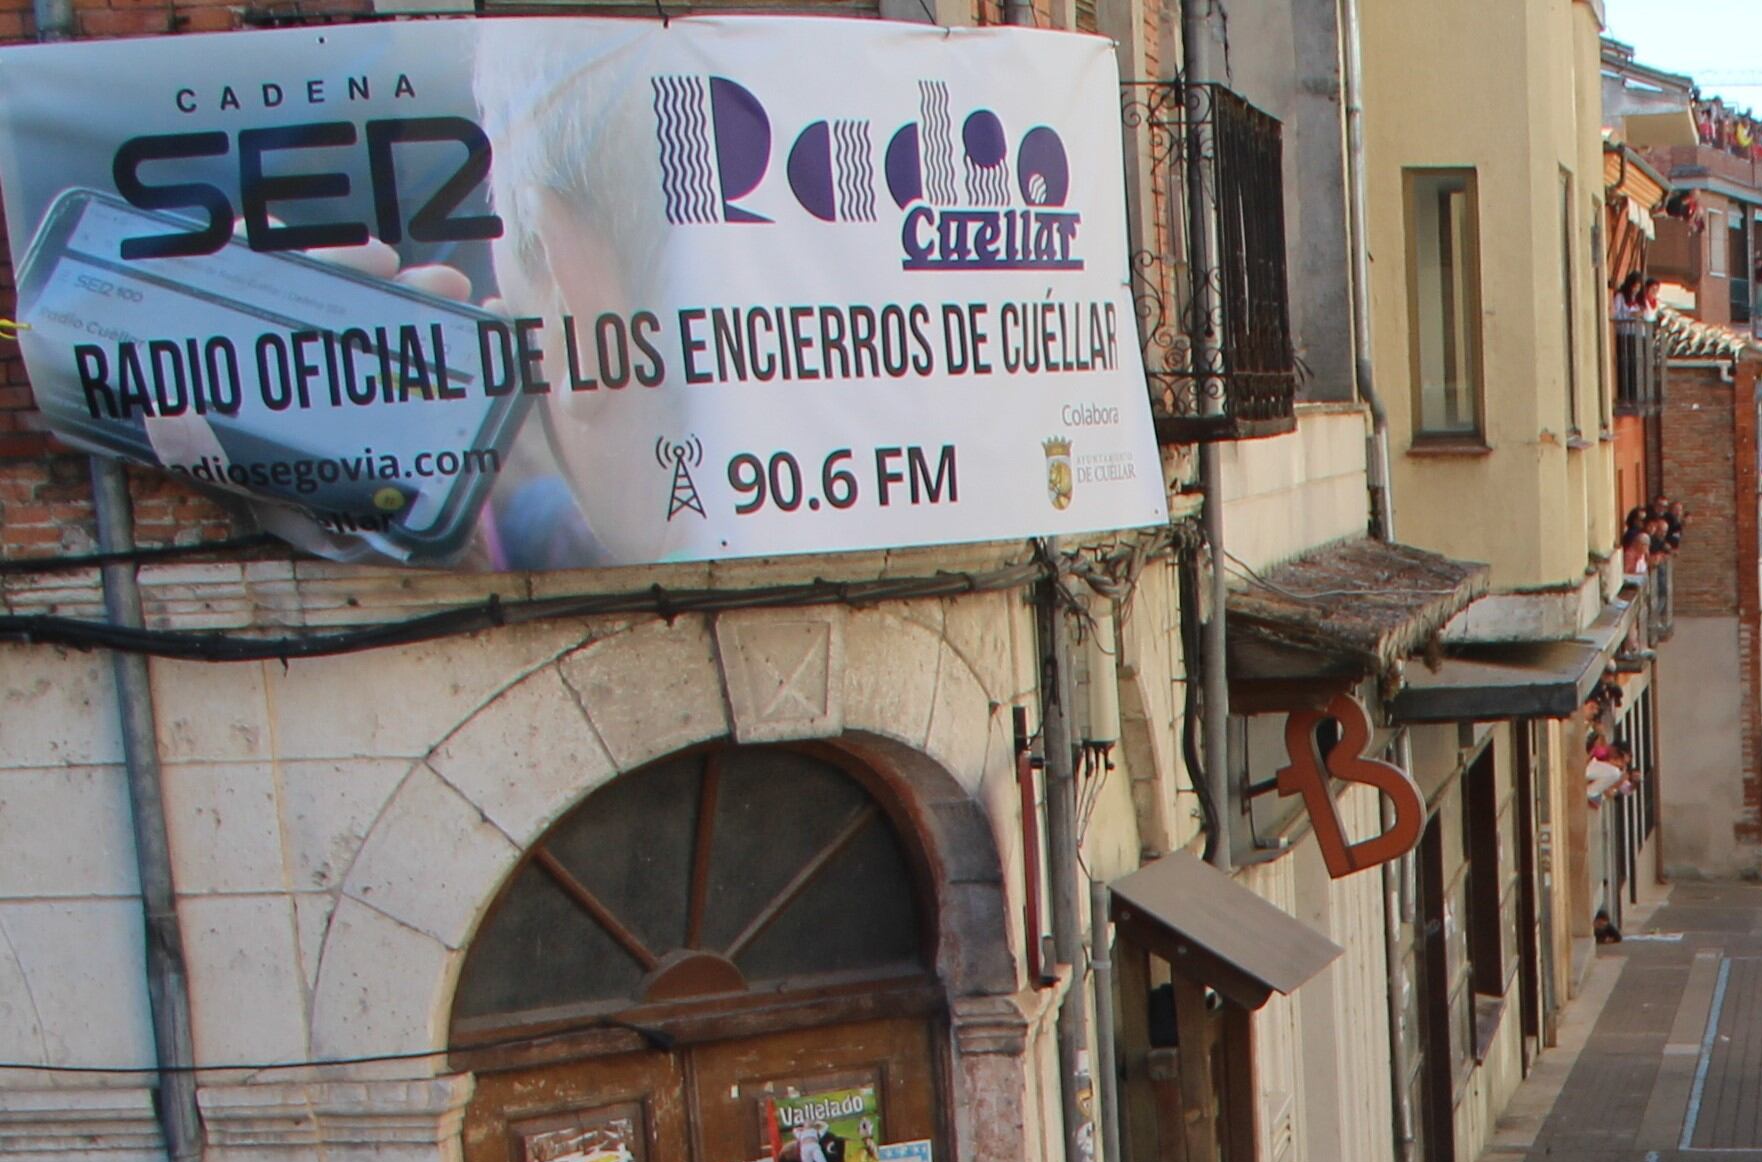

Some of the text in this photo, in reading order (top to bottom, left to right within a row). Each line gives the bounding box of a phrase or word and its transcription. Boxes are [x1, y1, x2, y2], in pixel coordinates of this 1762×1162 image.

[176, 74, 415, 113] CADENA
[651, 76, 1069, 223] Radio
[113, 116, 503, 260] SER
[74, 288, 1119, 418] RADIO OFICIAL DE LOS ENCIERROS DE CUÉLLAR
[1062, 402, 1119, 427] Colabora
[726, 445, 957, 515] 90.6 FM
[1077, 466, 1092, 483] DE
[1285, 693, 1427, 879] B
[780, 1094, 864, 1126] Vallelado
